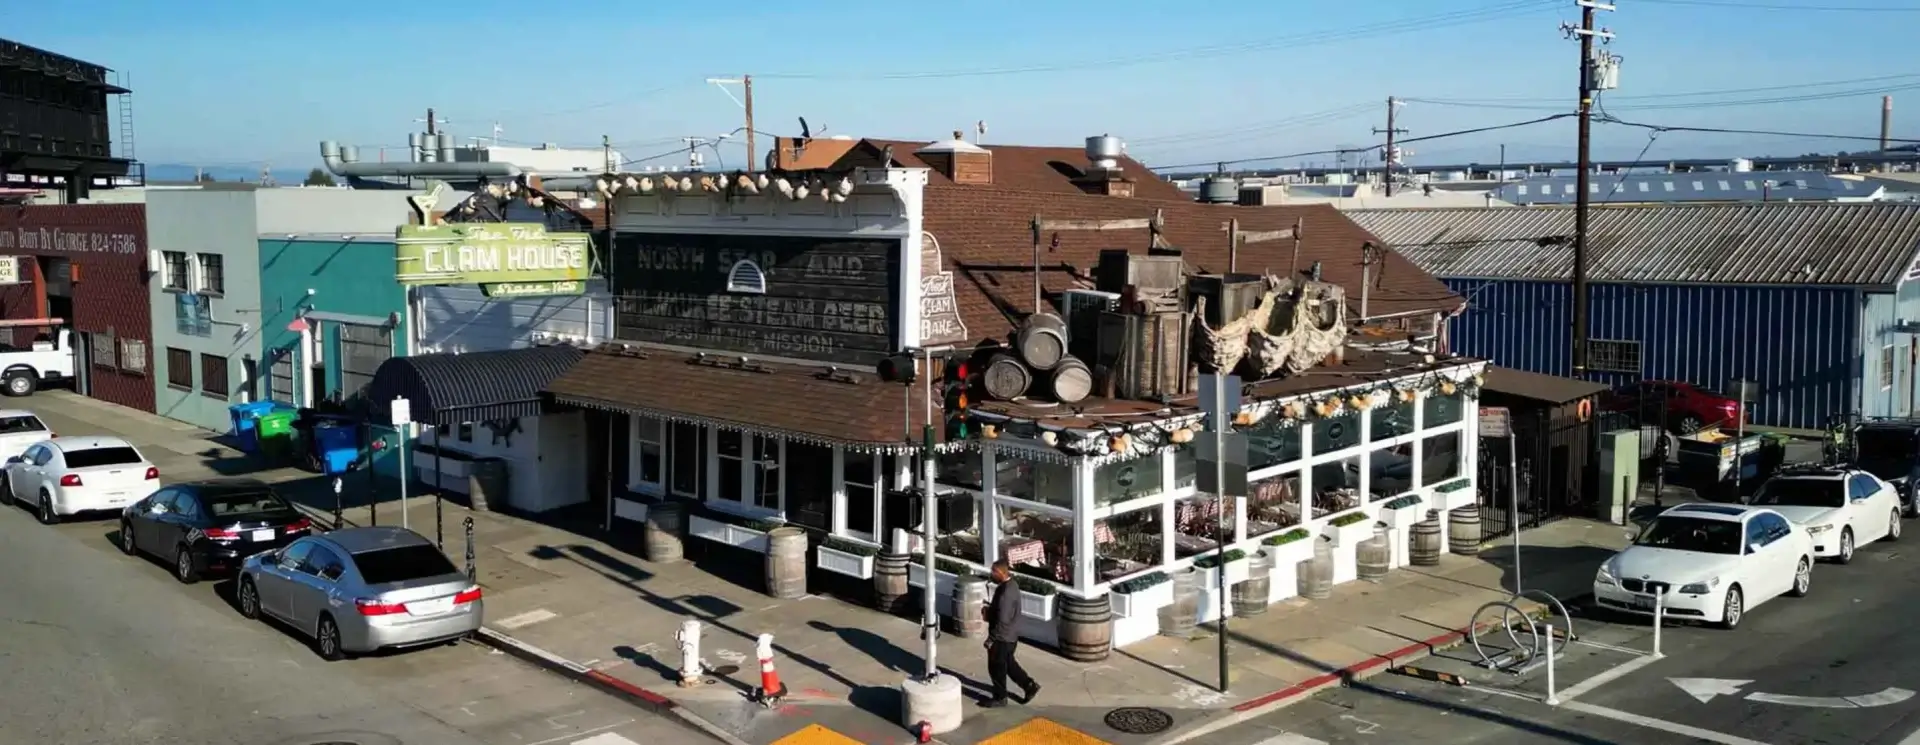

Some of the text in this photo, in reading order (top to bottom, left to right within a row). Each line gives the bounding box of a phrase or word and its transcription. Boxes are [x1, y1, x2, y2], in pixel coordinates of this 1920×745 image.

[0, 230, 15, 248] UTO
[54, 227, 89, 252] GEORGE
[91, 232, 136, 254] 824-7586
[424, 244, 583, 272] CLAM HOUSE
[638, 244, 705, 270] NORTH
[806, 254, 864, 275] AND
[739, 295, 815, 329] STEAM
[823, 302, 886, 335] BEER
[665, 323, 833, 353] BEST IN THE MISSION
